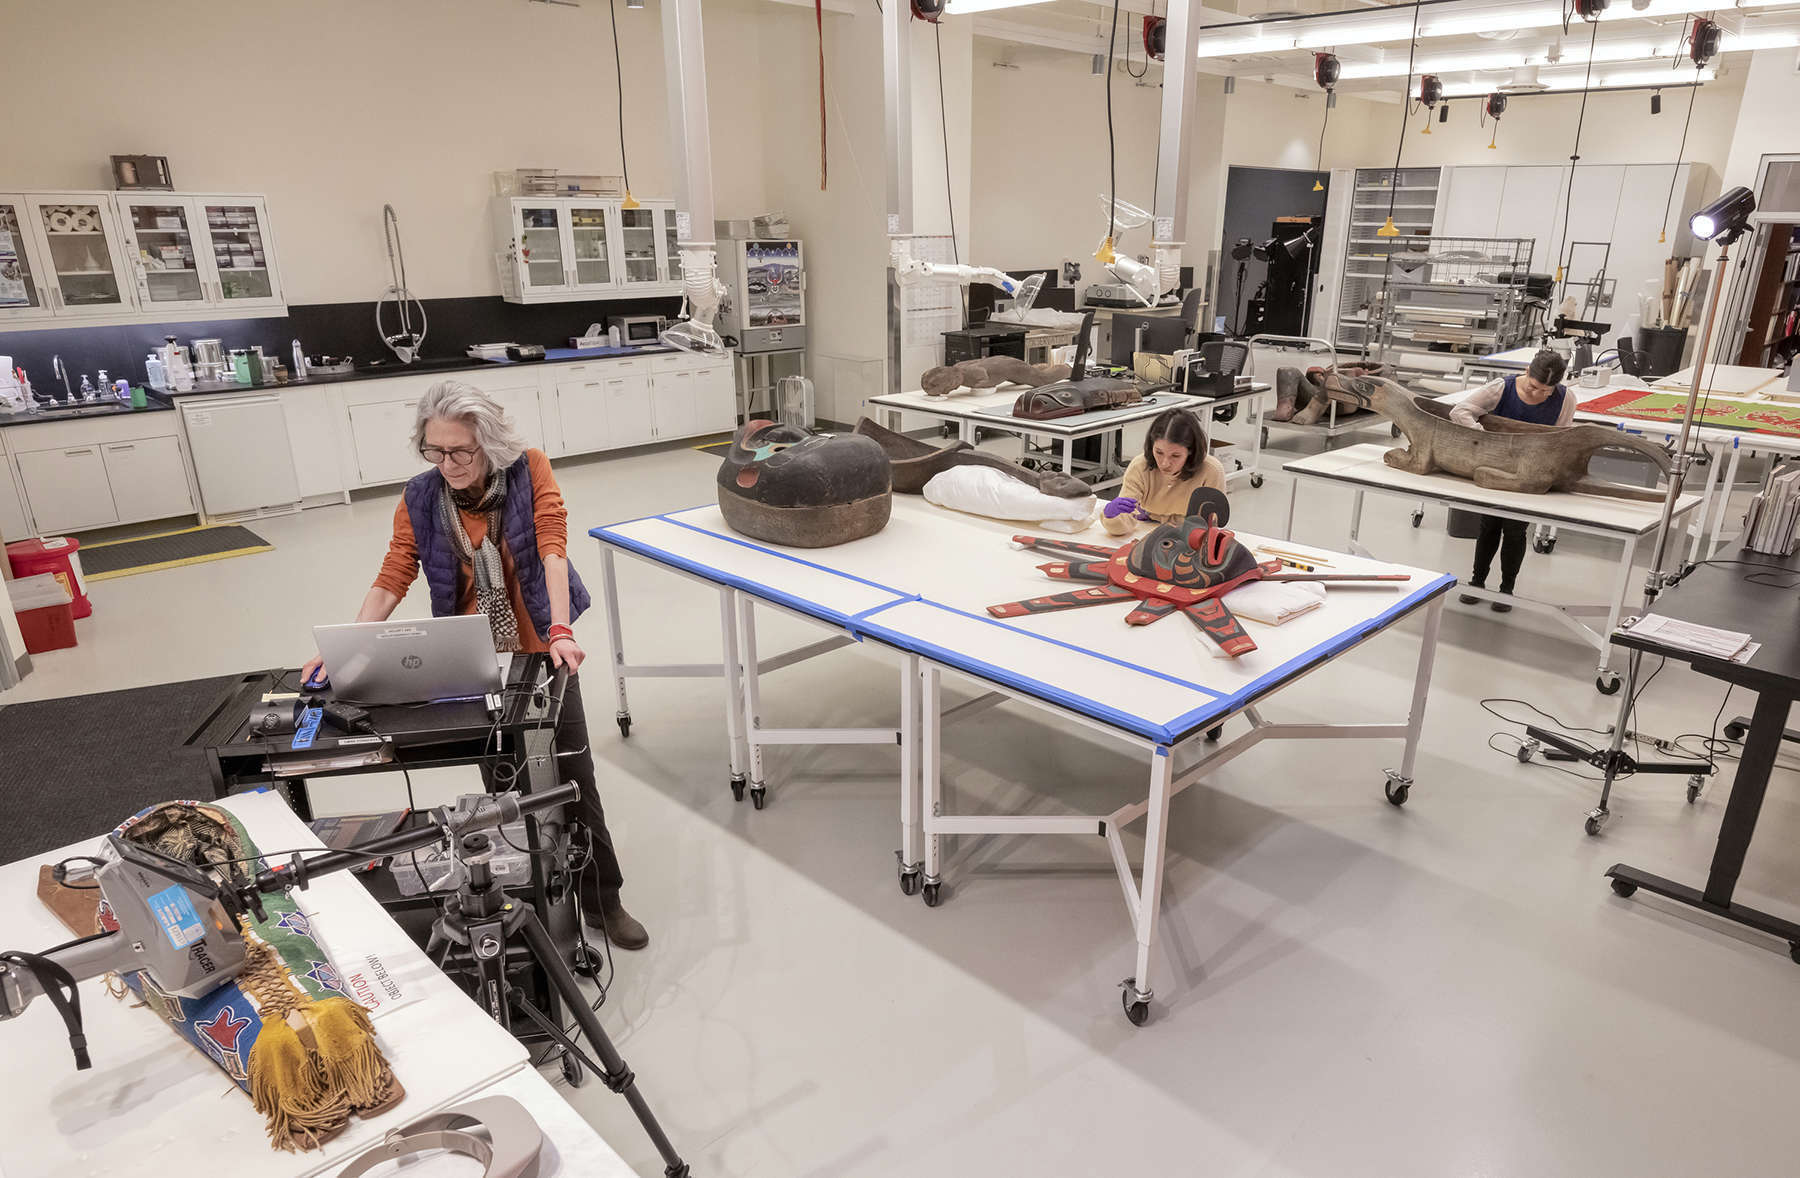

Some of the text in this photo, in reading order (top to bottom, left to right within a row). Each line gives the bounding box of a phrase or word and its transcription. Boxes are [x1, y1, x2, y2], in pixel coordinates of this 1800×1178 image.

[190, 938, 216, 974] TRACER
[348, 973, 381, 1010] CAUTION
[380, 979, 402, 1001] OBJECT
